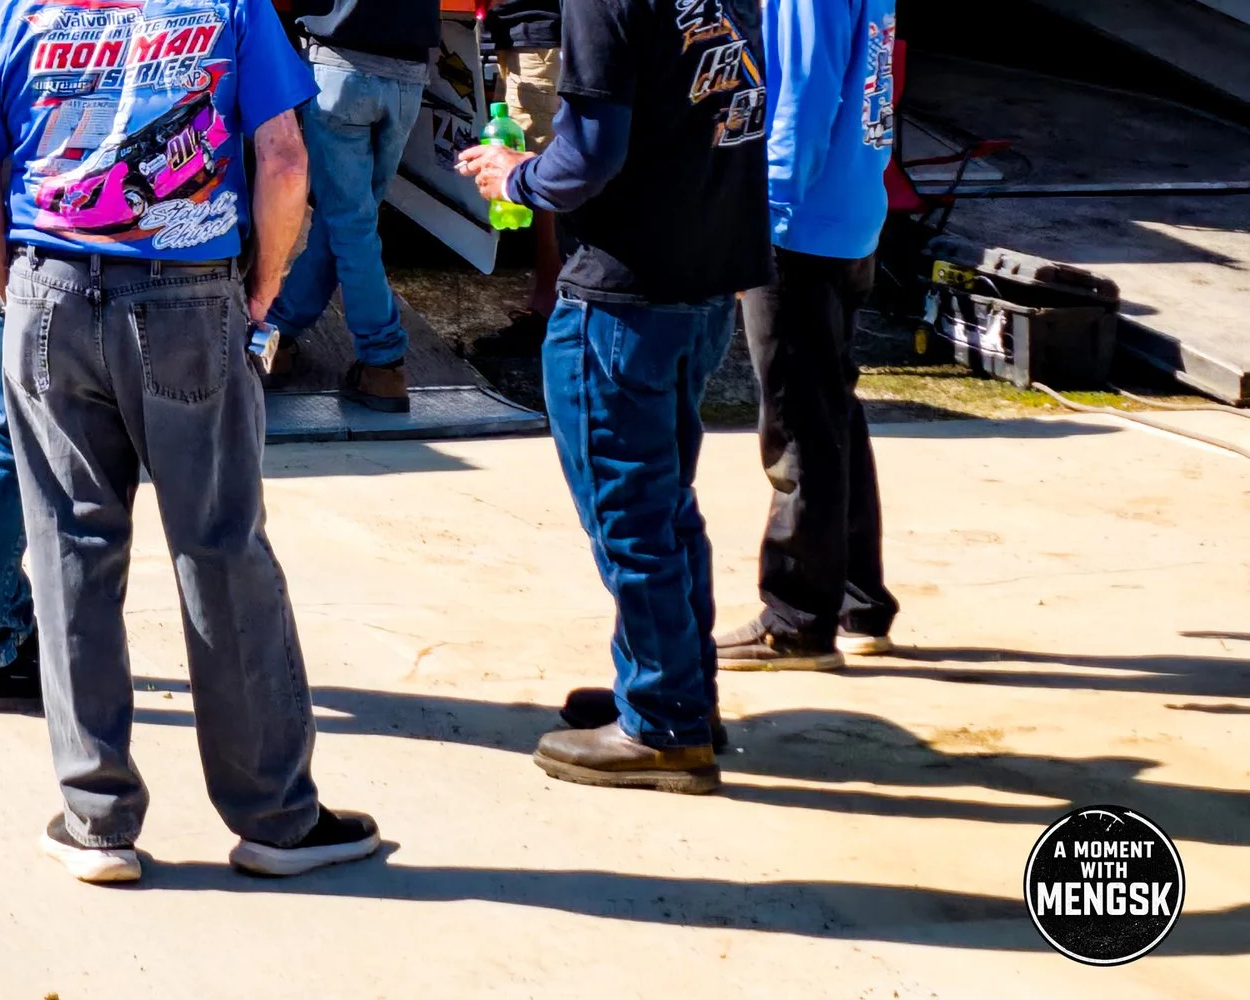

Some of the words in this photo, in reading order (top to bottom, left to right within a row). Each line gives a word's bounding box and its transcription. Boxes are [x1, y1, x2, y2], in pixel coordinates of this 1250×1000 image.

[59, 11, 136, 28] Valvoline
[34, 40, 124, 70] IRON
[128, 25, 217, 64] MAN
